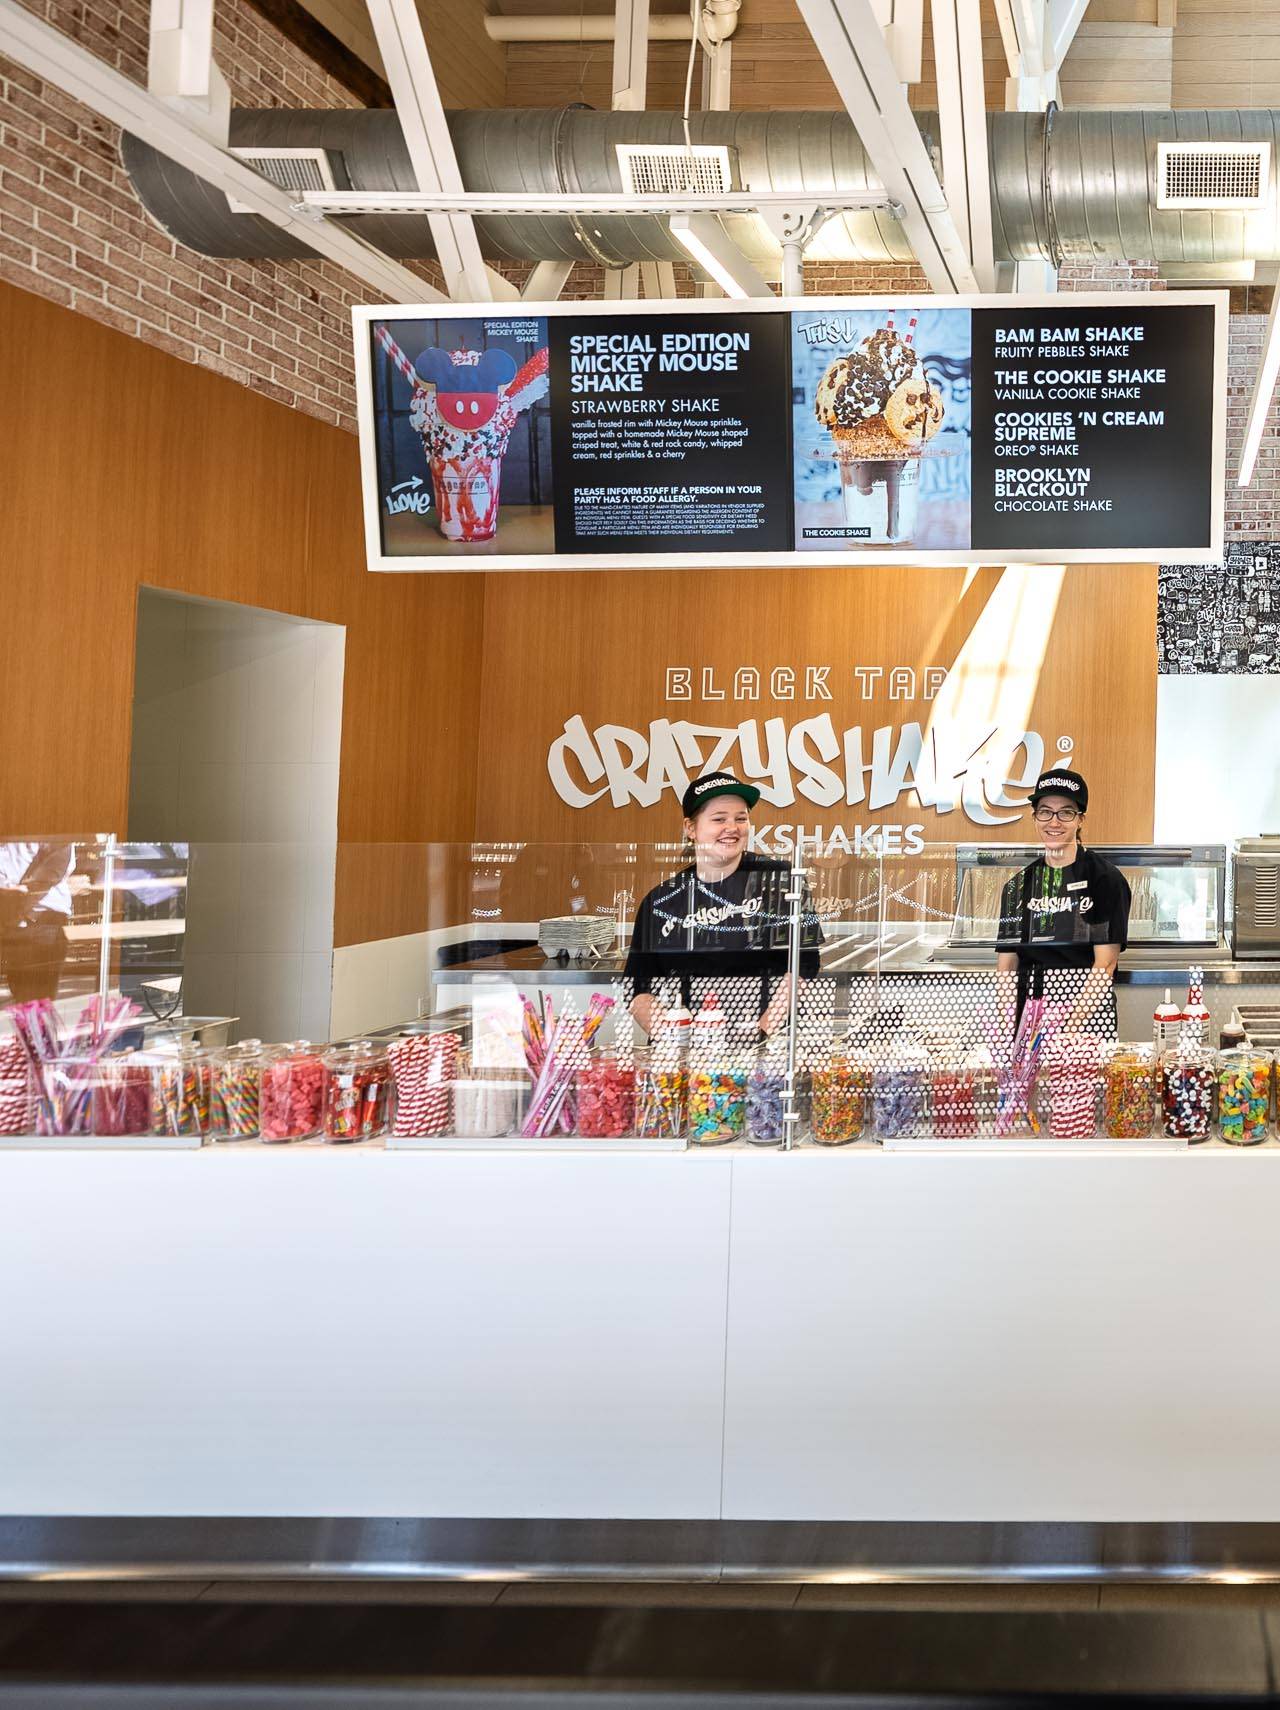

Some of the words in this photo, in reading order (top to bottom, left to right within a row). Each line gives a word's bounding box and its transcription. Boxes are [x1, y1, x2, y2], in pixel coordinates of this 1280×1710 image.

[995, 328, 1034, 343] BAM
[1040, 327, 1079, 342] BAM
[1085, 326, 1143, 342] SHAKE
[570, 335, 656, 355] SPECIAL
[662, 333, 749, 352] EDITION
[995, 346, 1033, 358] FRUITY
[1038, 345, 1085, 357] PEBBLES
[1089, 345, 1128, 357] SHAKE
[571, 355, 653, 374] MICKEY
[659, 353, 737, 371] MOUSE
[994, 370, 1027, 384] THE
[1033, 369, 1101, 384] COOKIE
[1107, 368, 1165, 383] SHAKE
[571, 374, 642, 393] SHAKE
[994, 388, 1044, 400] VANILLA
[1048, 387, 1096, 399] COOKIE
[1101, 387, 1140, 399] SHAKE
[571, 400, 665, 414] STRAWBERRY
[671, 398, 719, 412] SHAKE
[571, 420, 597, 429] vanilla
[597, 419, 622, 428] frosted
[624, 420, 635, 428] rim
[637, 419, 653, 427] with
[655, 419, 682, 430] Mickey
[683, 419, 708, 427] Mouse
[710, 418, 741, 428] sprinkles
[994, 412, 1072, 426] COOKIES
[1078, 411, 1096, 425] 'N
[1102, 411, 1163, 425] CREAM
[572, 430, 598, 440] topped
[599, 429, 614, 438] with
[624, 429, 664, 438] homemade
[666, 428, 692, 439] Mickey
[694, 428, 719, 437] Mouse
[721, 428, 748, 438] shaped
[995, 427, 1075, 441] SUPREME
[572, 440, 598, 451] crisped
[600, 441, 619, 450] treat,
[621, 440, 641, 449] white
[642, 440, 650, 449] &
[651, 439, 663, 448] red
[665, 439, 681, 448] rock
[683, 439, 708, 450] candy,
[710, 439, 742, 449] whipped
[1039, 444, 1078, 456] SHAKE
[572, 450, 597, 460] cream,
[599, 450, 612, 459] red
[614, 449, 645, 460] sprinkles
[646, 449, 653, 458] &
[662, 449, 685, 460] cherry
[995, 468, 1090, 482] BROOKLYN
[574, 487, 605, 495] PLEASE
[607, 487, 641, 495] INFORM
[643, 486, 669, 494] STAFF
[671, 486, 678, 494] IF
[680, 486, 688, 494] A
[689, 486, 723, 494] PERSON
[725, 485, 735, 494] IN
[737, 485, 761, 493] YOUR
[995, 484, 1087, 497] BLACKOUT
[574, 494, 601, 504] PARTY
[603, 494, 620, 503] HAS
[622, 494, 629, 503] A
[631, 493, 656, 503] FOOD
[657, 493, 698, 503] ALLERGY.
[994, 500, 1068, 512] CHOCOLATE
[1073, 499, 1112, 511] SHAKE
[804, 529, 818, 537] THE
[819, 529, 845, 537] COOKIE
[846, 529, 869, 537] SHAKE
[666, 666, 833, 700] BLACK
[855, 666, 950, 700] TAP
[749, 824, 925, 857] KSHAKES
